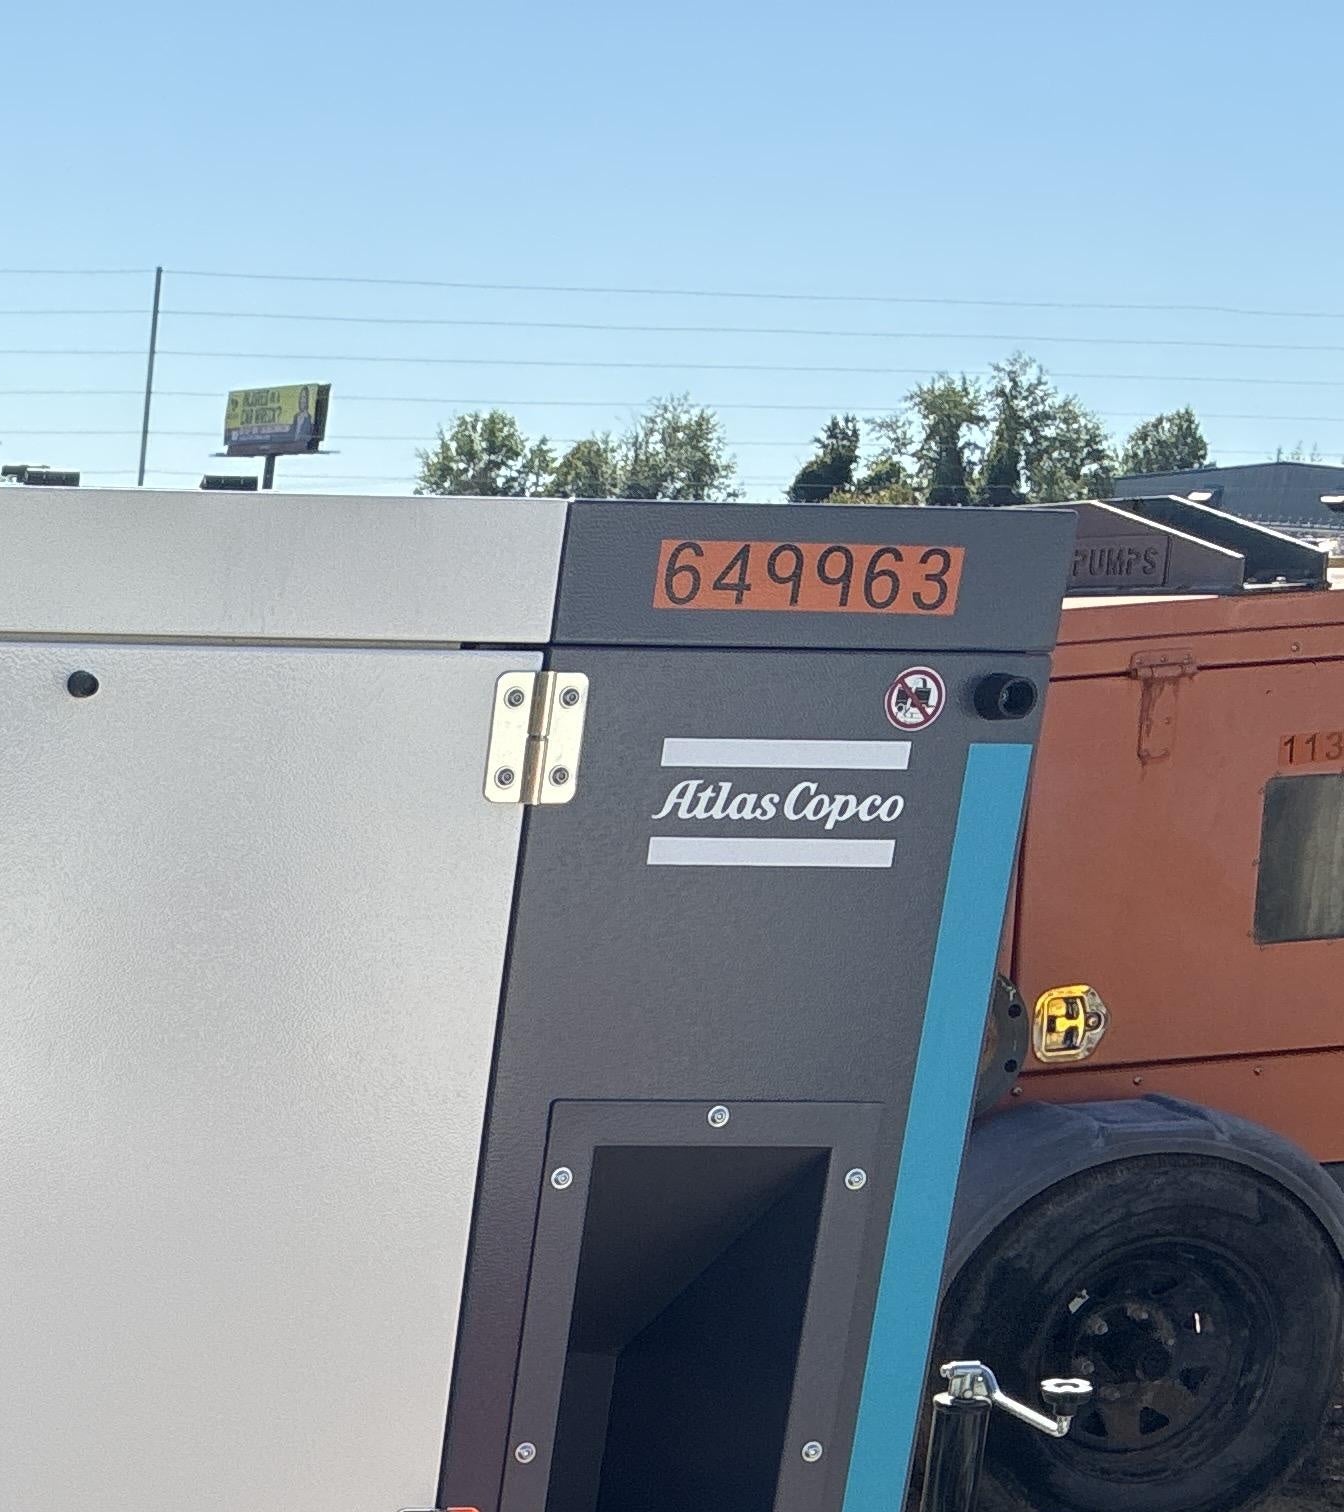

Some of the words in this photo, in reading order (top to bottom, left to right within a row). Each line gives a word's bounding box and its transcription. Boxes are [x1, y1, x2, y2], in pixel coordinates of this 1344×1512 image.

[664, 541, 953, 611] 649963
[1072, 547, 1158, 577] PUMPS
[1284, 731, 1343, 764] 113
[651, 779, 780, 820] Atlas
[783, 781, 905, 830] Copco
